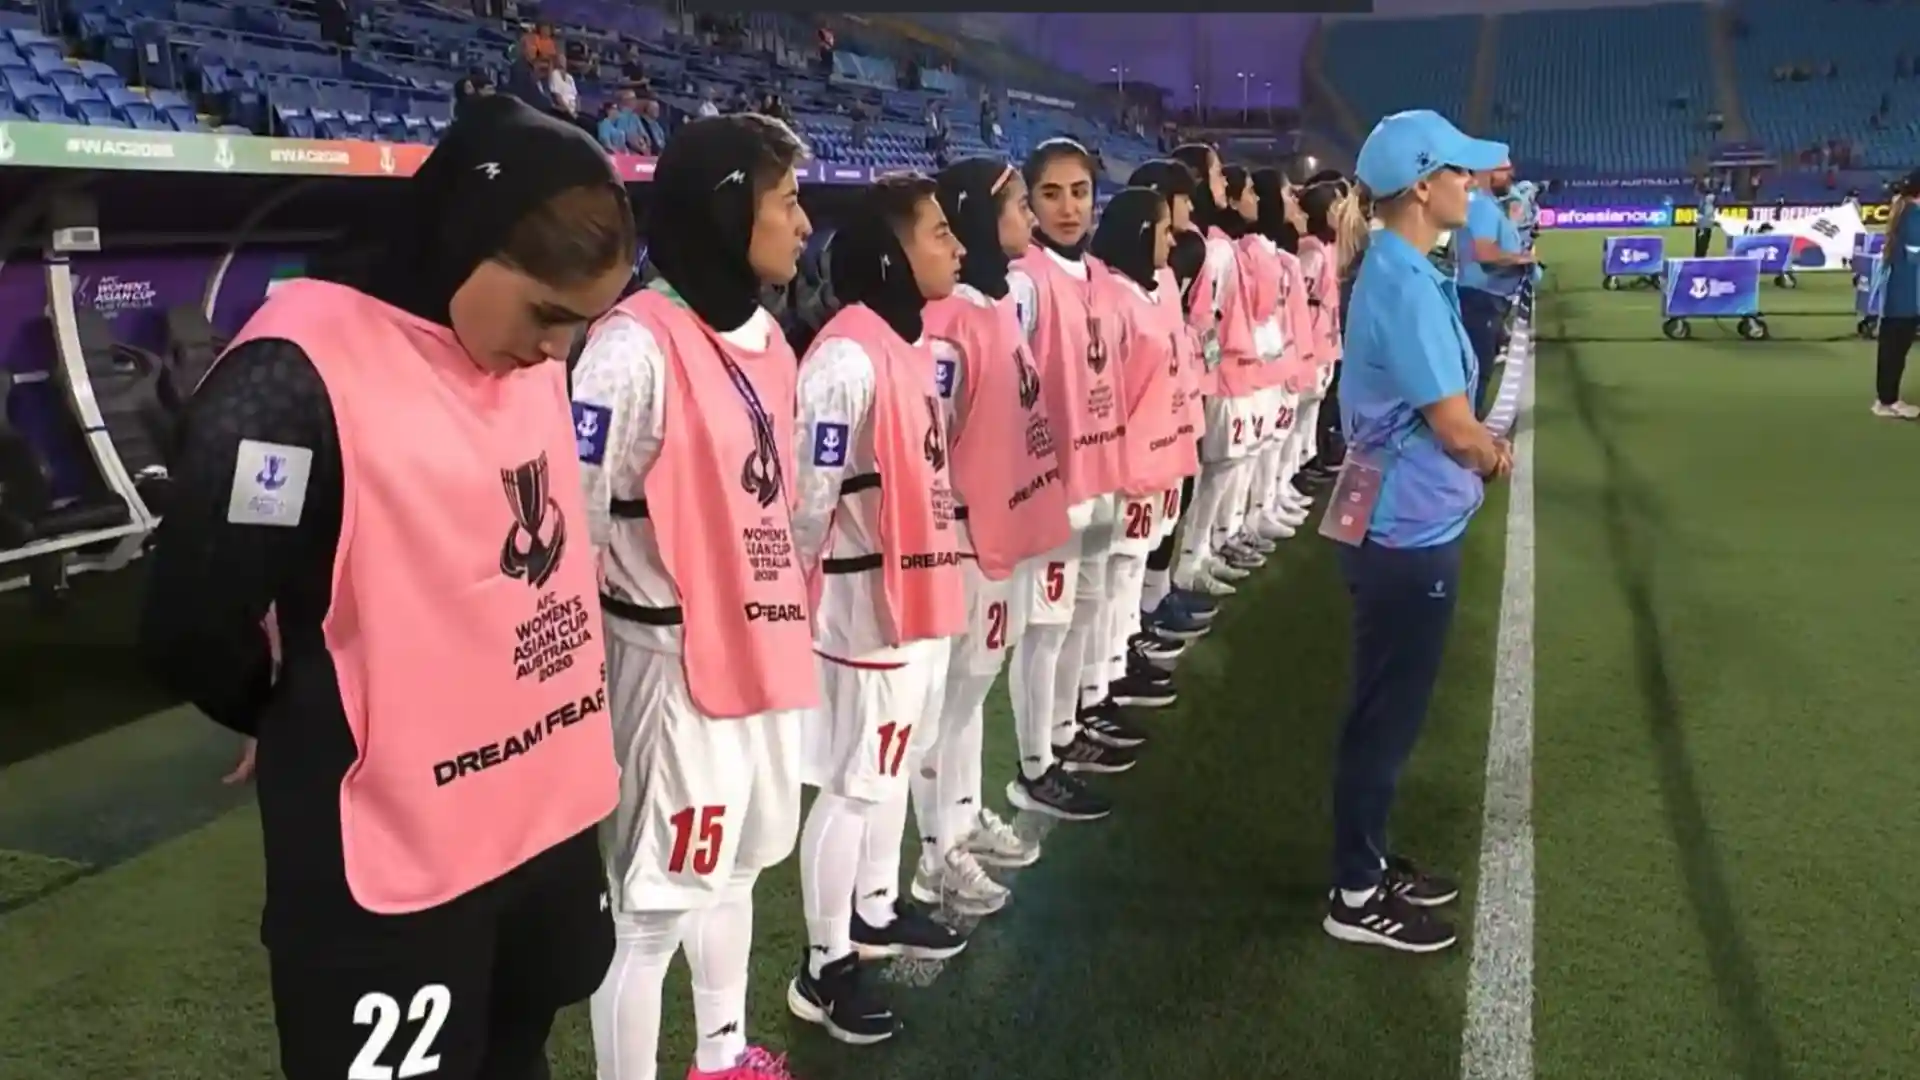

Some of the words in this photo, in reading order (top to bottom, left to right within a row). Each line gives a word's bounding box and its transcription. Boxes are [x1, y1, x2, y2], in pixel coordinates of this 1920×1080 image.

[1126, 502, 1152, 539] 26
[537, 591, 556, 613] AFC
[1046, 561, 1065, 602] 5
[513, 625, 556, 665] ASIAN
[558, 610, 588, 637] CUP
[515, 594, 582, 642] WOMEN'S
[515, 629, 592, 681] AUSTRALIA
[433, 720, 543, 787] DREAM
[877, 721, 912, 777] 11
[668, 805, 726, 875] 15
[347, 983, 451, 1080] 22
